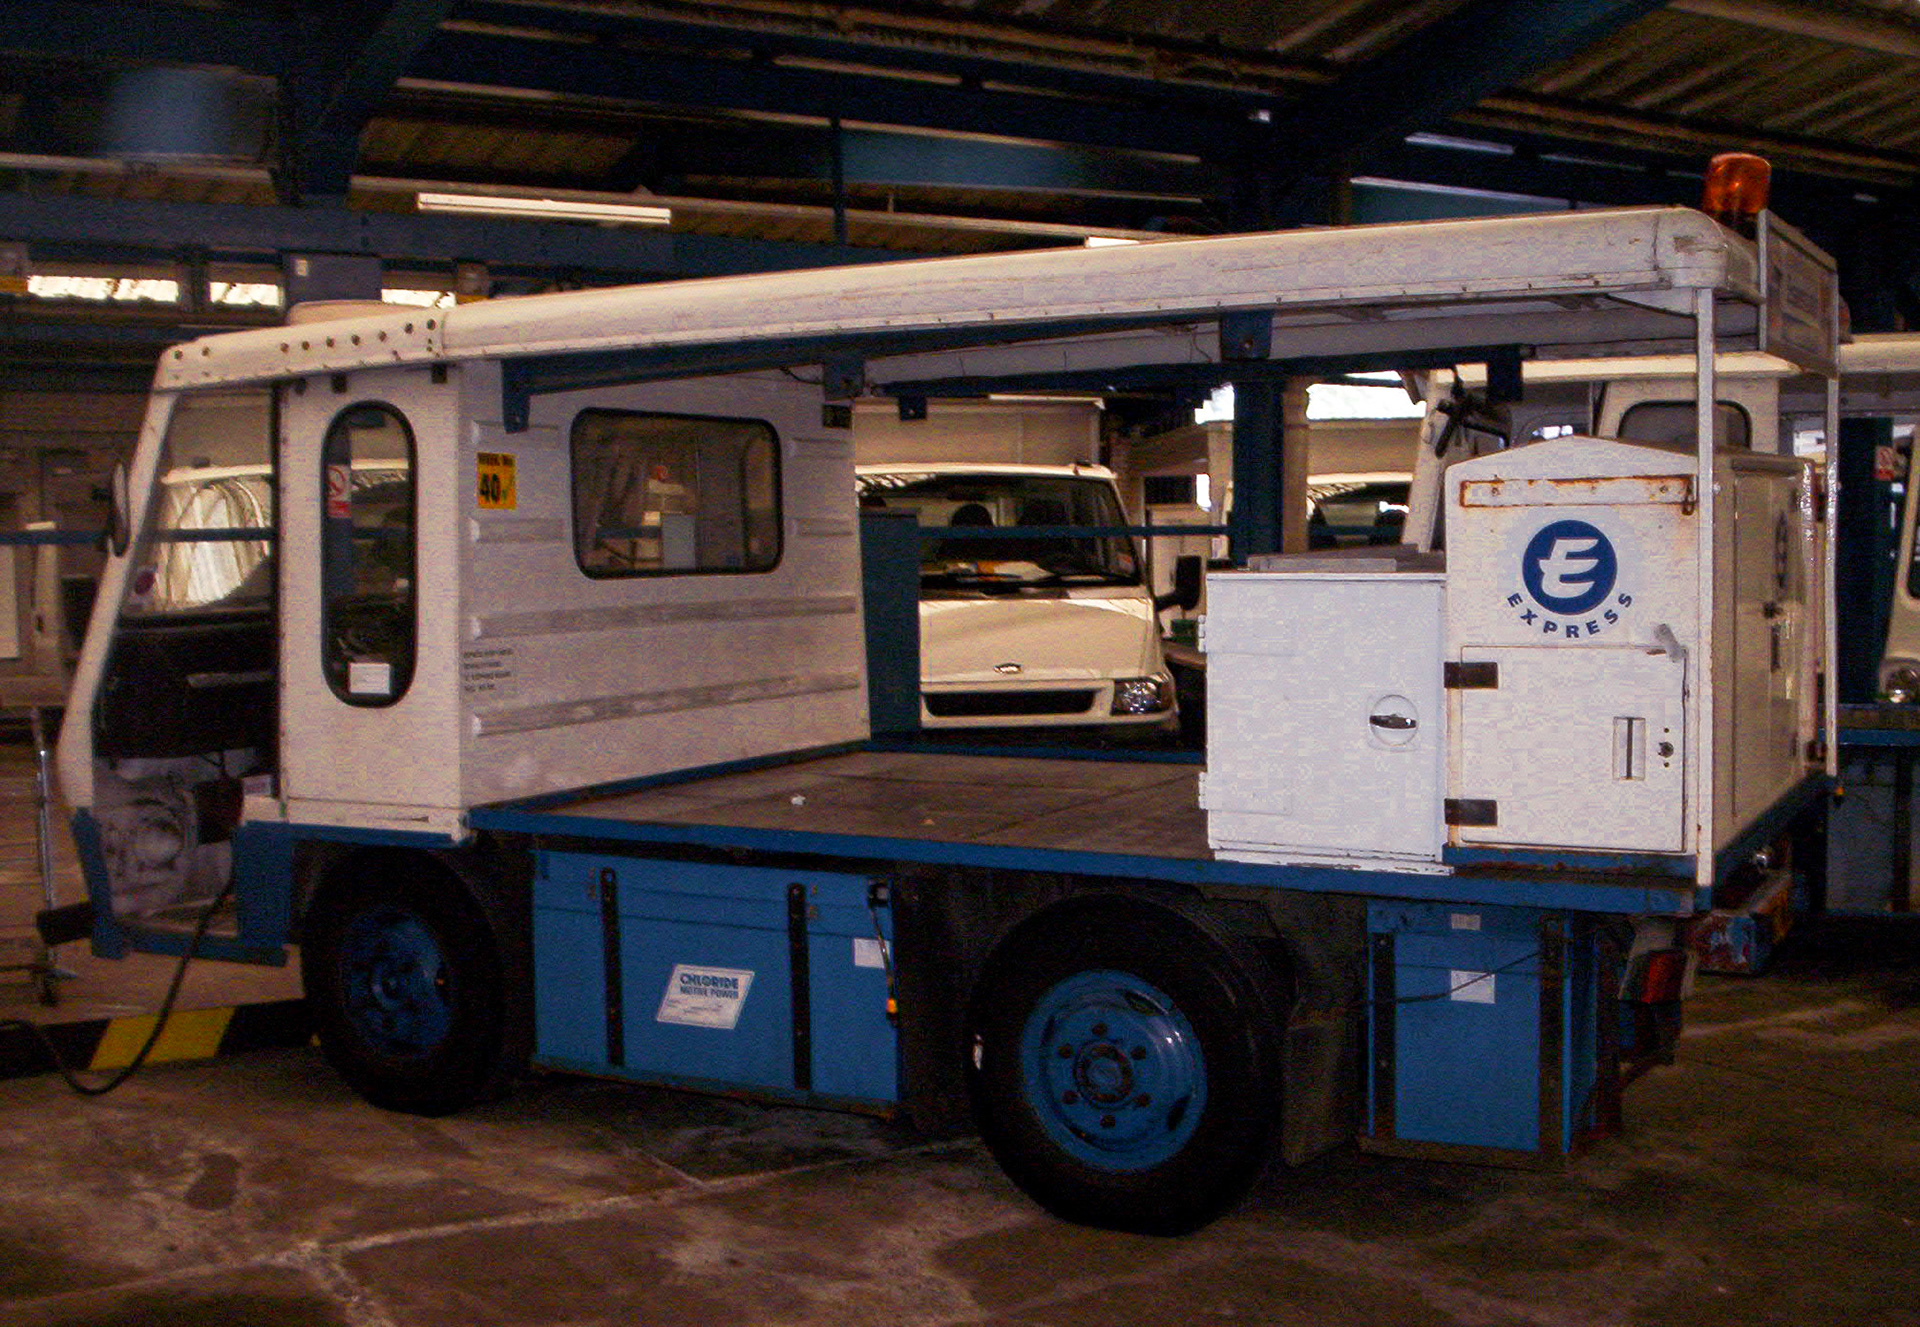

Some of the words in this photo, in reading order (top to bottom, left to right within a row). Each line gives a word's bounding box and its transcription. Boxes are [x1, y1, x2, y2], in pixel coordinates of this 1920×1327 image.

[1538, 538, 1599, 599] E
[1507, 592, 1633, 638] EXPRESS
[679, 973, 739, 989] CHLORIDE
